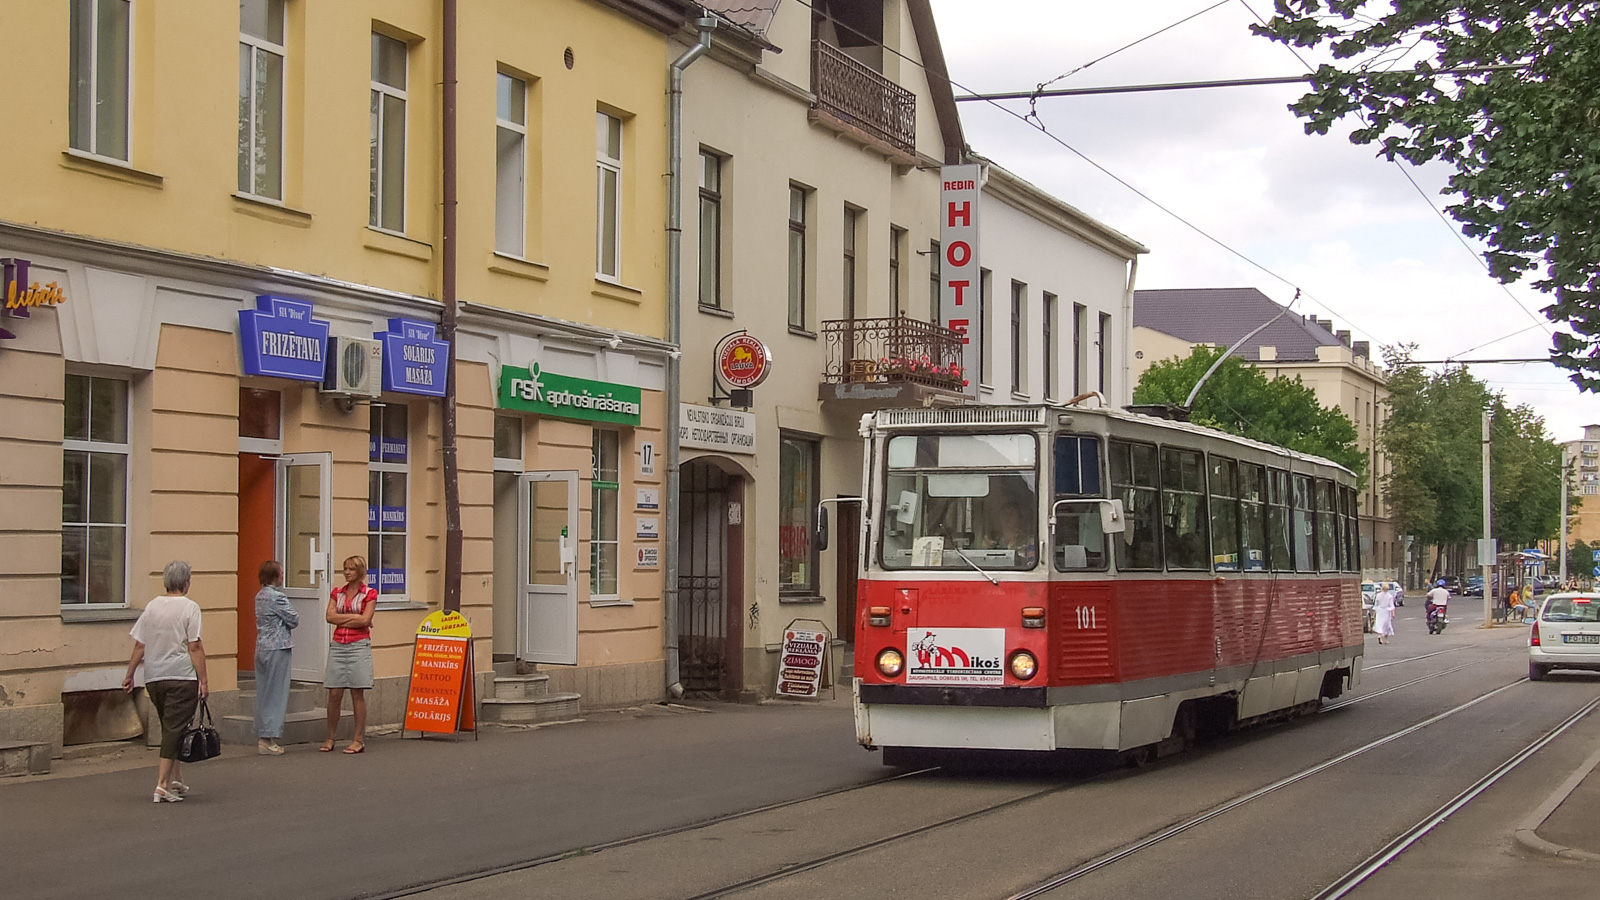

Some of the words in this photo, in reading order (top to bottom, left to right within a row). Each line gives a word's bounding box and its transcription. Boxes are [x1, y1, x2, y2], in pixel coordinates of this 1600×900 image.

[944, 180, 975, 191] REBIR
[946, 201, 972, 368] HOTE
[262, 330, 321, 362] FRIZĒTAVA
[403, 343, 435, 364] SOLĀRIJS
[405, 366, 433, 386] MASĀŽA
[731, 362, 755, 371] LAUVA
[643, 444, 652, 465] 17
[1075, 605, 1096, 629] 101
